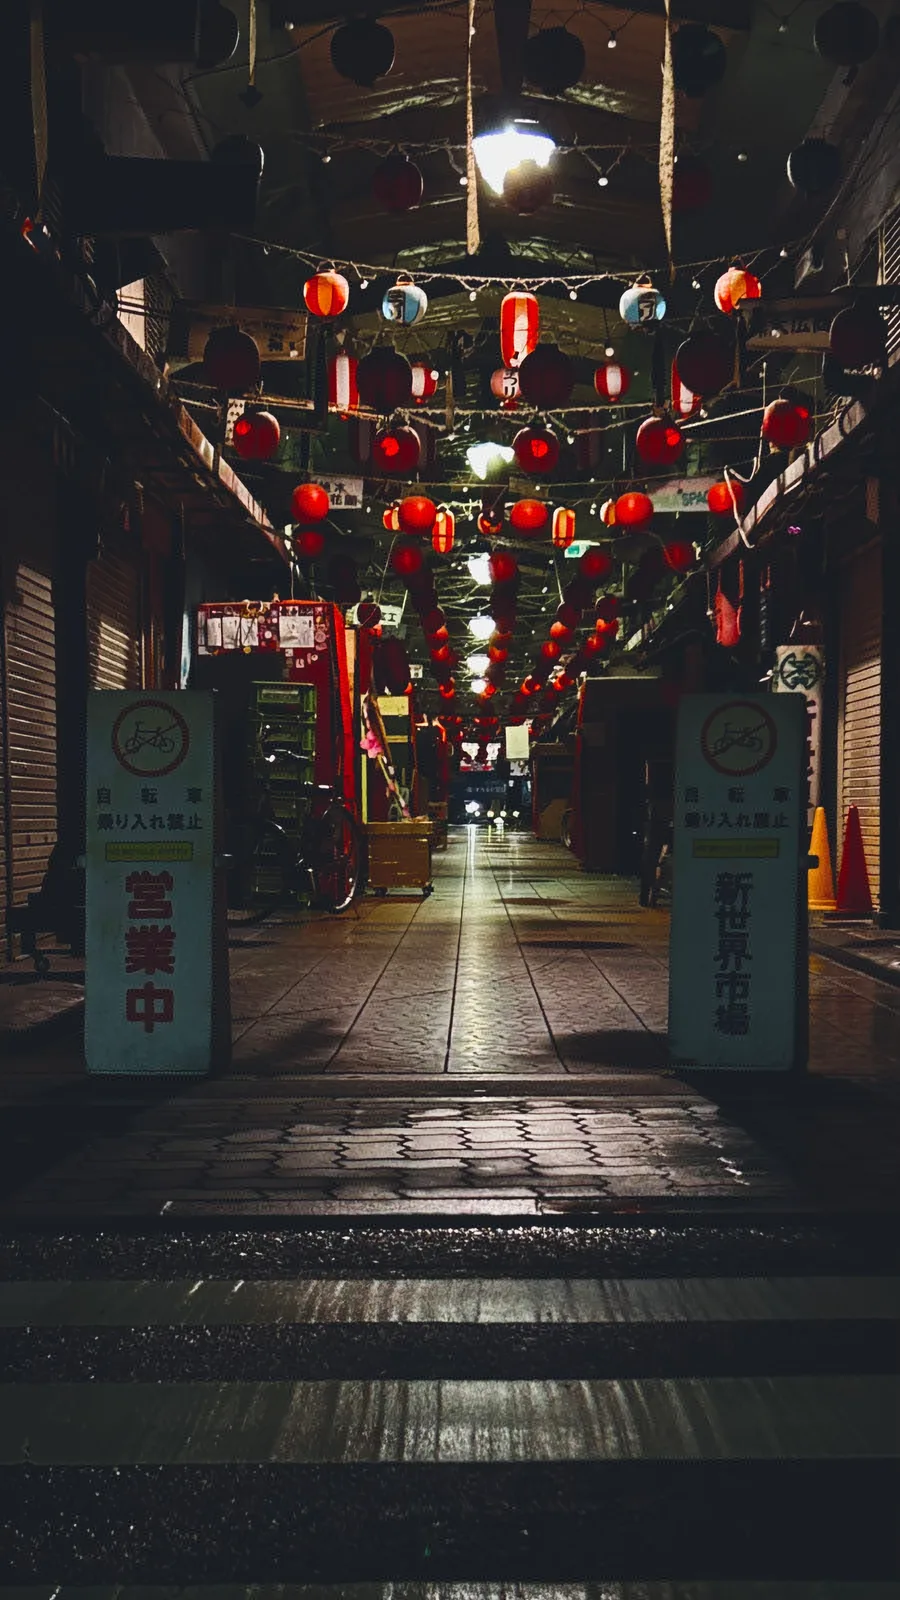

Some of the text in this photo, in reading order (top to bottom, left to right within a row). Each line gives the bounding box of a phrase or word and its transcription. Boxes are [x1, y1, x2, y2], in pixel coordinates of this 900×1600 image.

[97, 786, 203, 804] 自転車
[97, 812, 203, 831] 乗り入れ禁止
[124, 870, 176, 1034] 営業中
[713, 871, 754, 1036] 新世界市場
